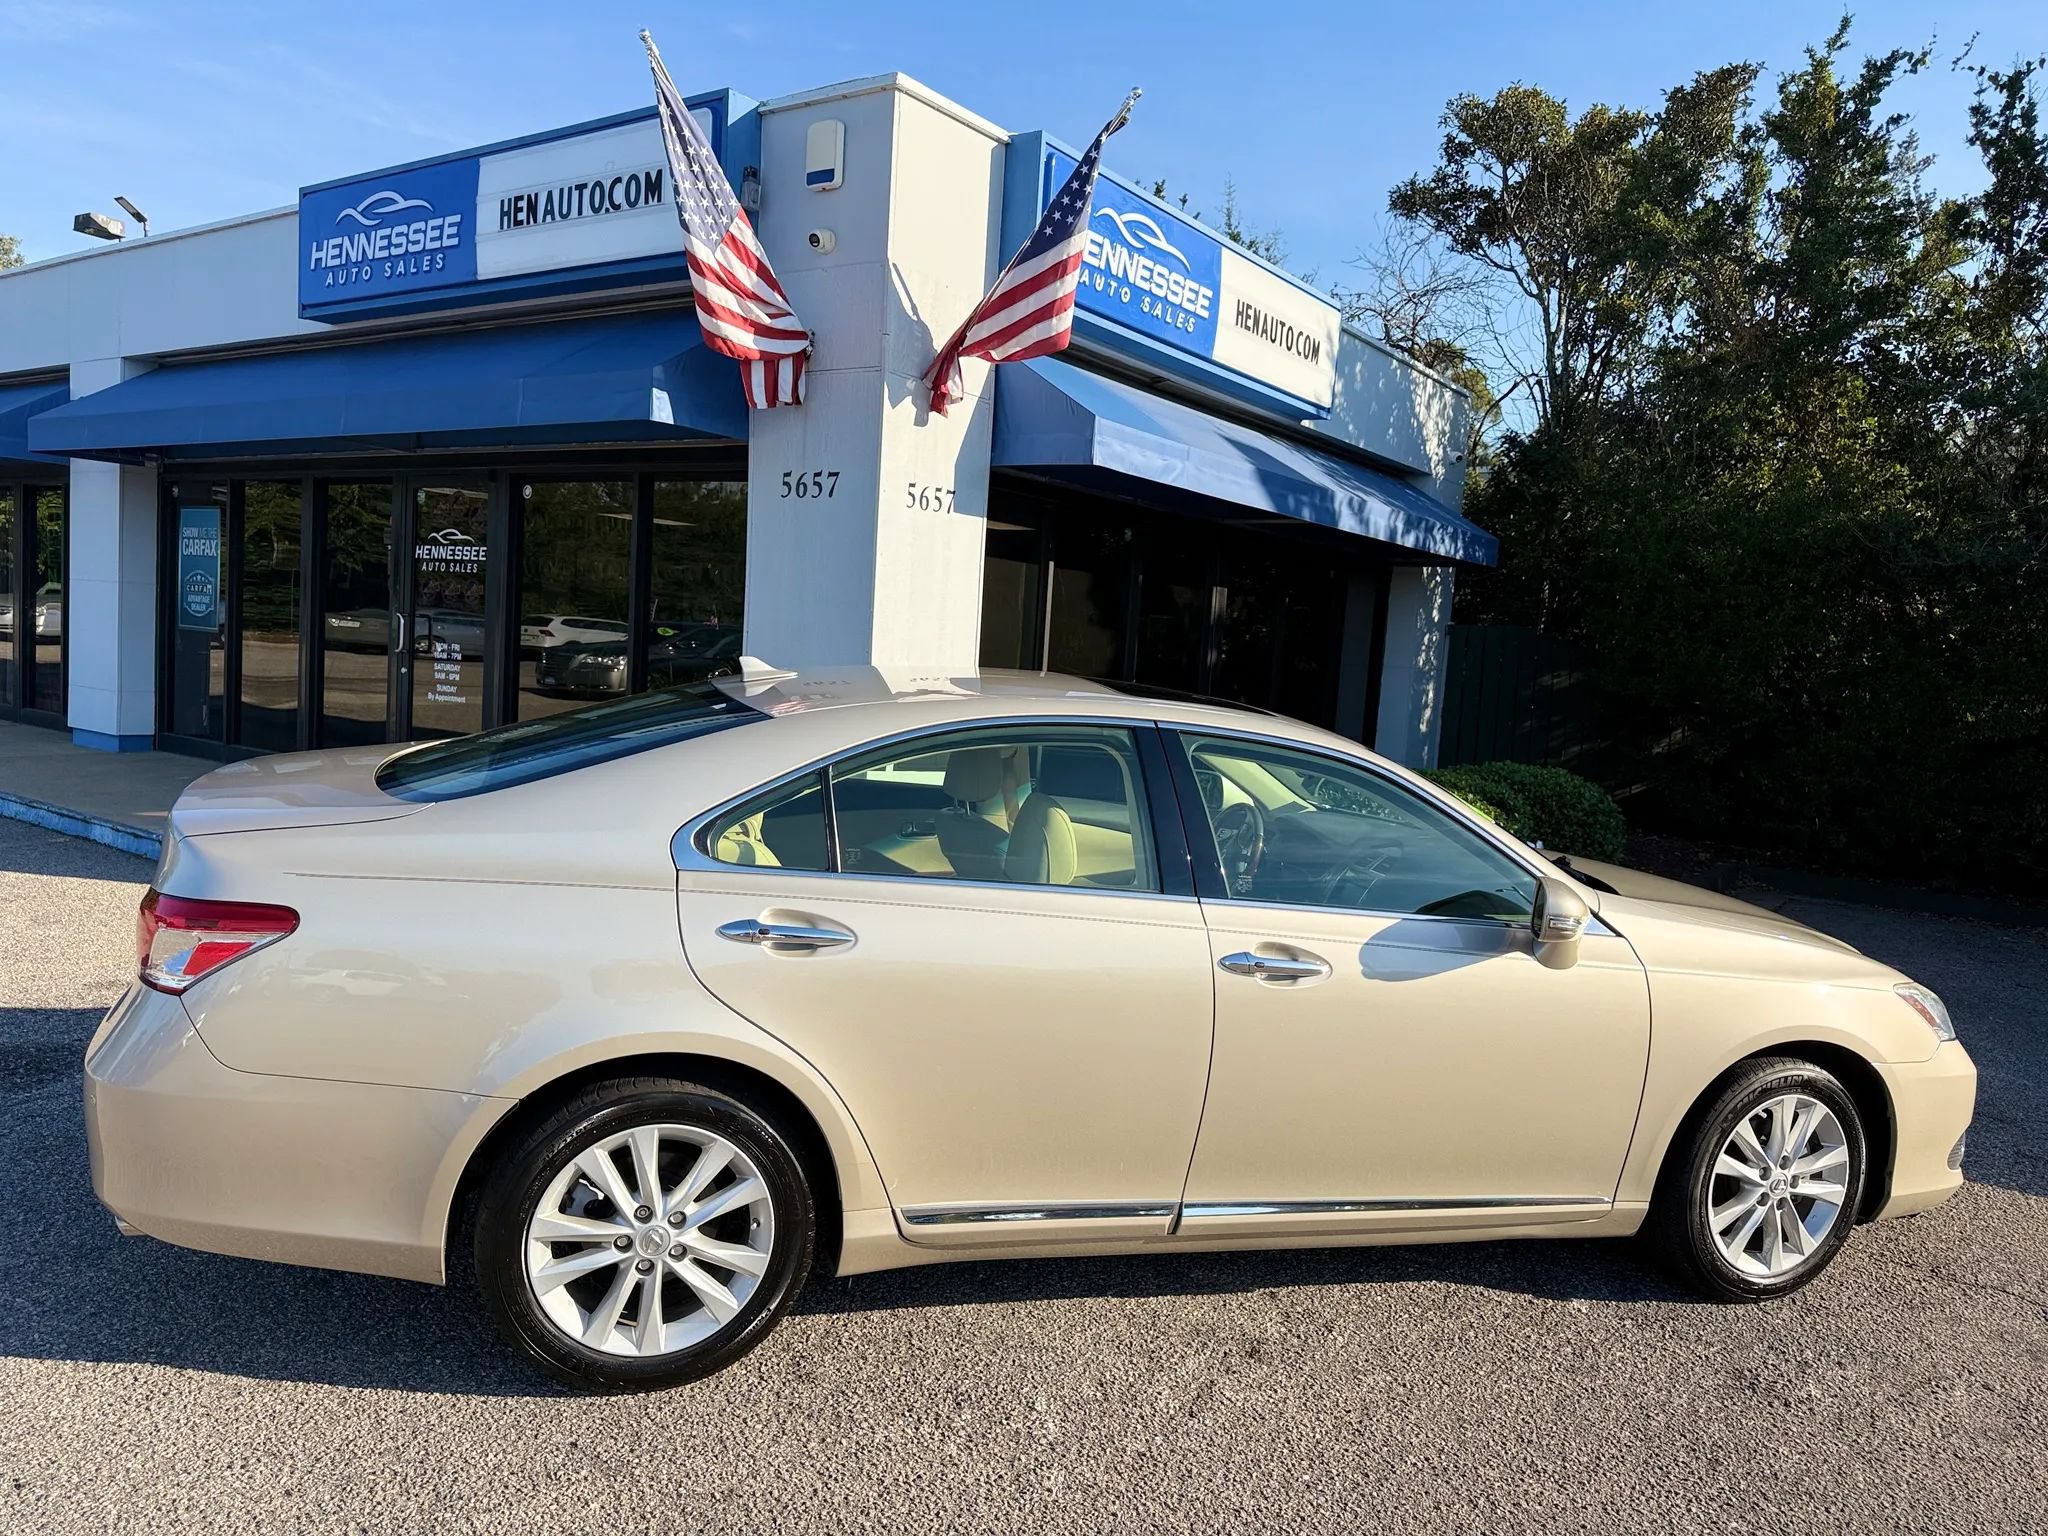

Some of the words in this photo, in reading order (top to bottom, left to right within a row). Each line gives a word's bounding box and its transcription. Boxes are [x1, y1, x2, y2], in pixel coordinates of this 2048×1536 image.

[499, 168, 663, 231] HENAUTO.COM
[310, 213, 462, 270] HENNESSEE
[325, 266, 371, 287] AUTO
[384, 253, 444, 277] SALES
[1082, 229, 1214, 319] ENNESSEE
[1079, 267, 1131, 303] AUTO
[1140, 295, 1196, 333] SALES
[780, 470, 841, 499] 5657
[905, 482, 956, 514] 5657
[182, 527, 198, 538] SHOW
[182, 538, 217, 557] CARFAX
[415, 545, 488, 561] HENNESSEE
[421, 562, 446, 572] AUTO
[449, 562, 478, 573] SALES
[187, 594, 210, 604] ADVANTAGE
[190, 603, 206, 611] DEALER
[451, 643, 461, 651] FRI
[451, 652, 462, 660] 7PM
[433, 662, 461, 672] SATURDAY
[436, 683, 458, 693] SUNDAY
[427, 692, 435, 702] By
[435, 693, 466, 703] Appointment
